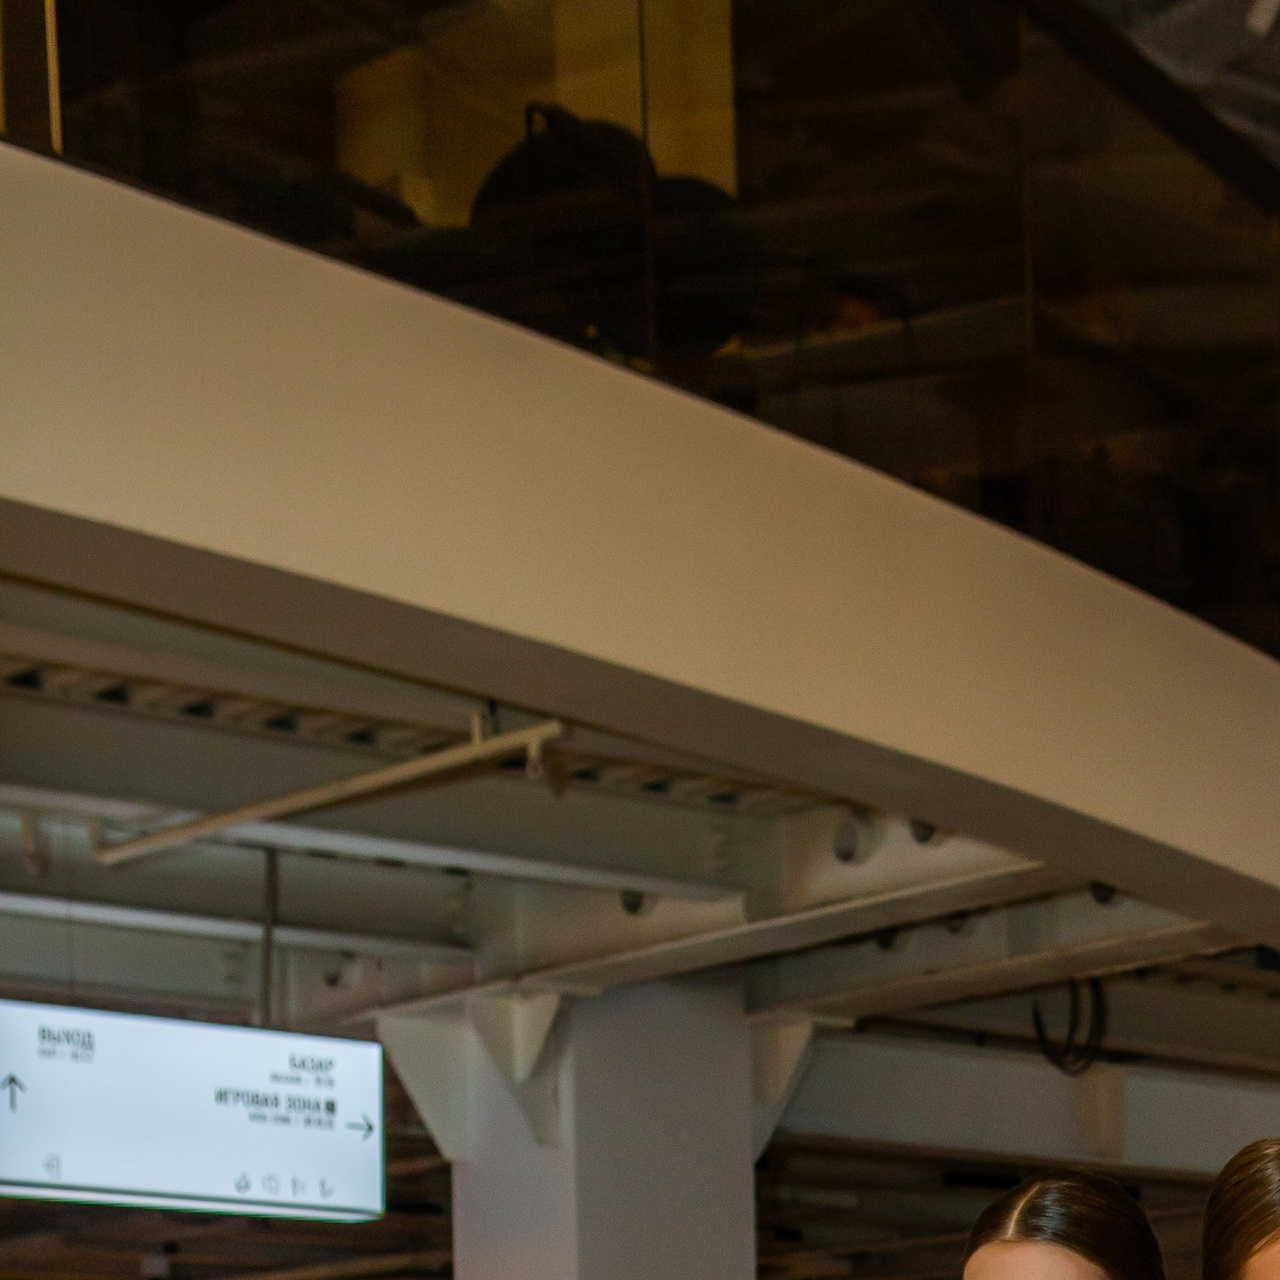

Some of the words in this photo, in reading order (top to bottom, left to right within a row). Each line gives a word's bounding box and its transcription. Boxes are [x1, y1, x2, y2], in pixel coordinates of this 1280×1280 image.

[38, 1025, 94, 1050] ВЫХОД
[289, 1052, 336, 1072] БАЗАР
[214, 1087, 281, 1109] ИГРОВАЯ
[285, 1094, 321, 1113] ЗОНА
